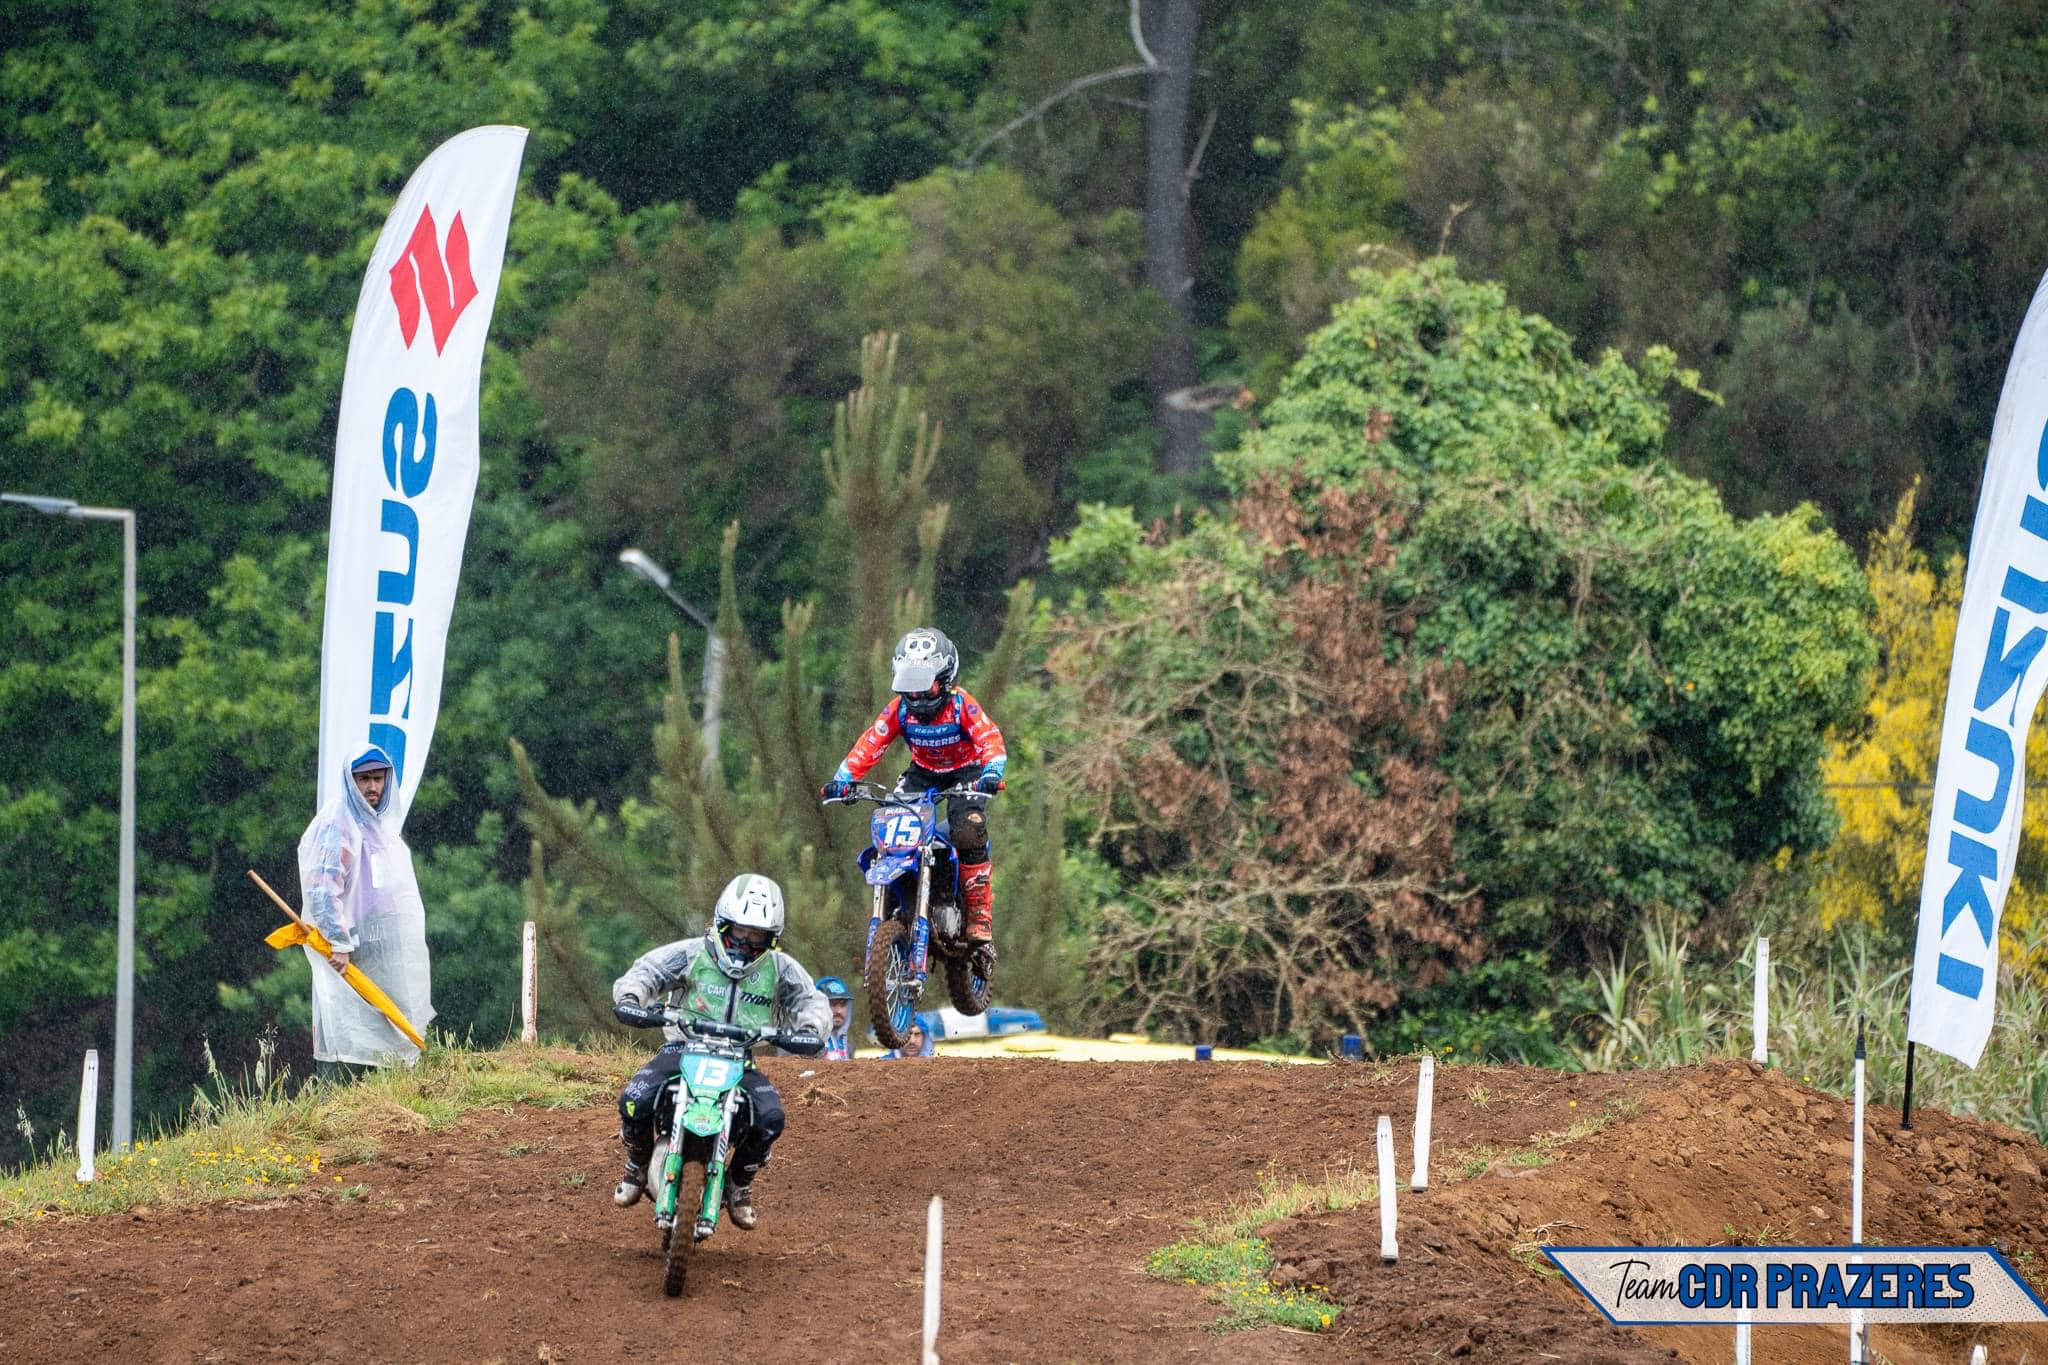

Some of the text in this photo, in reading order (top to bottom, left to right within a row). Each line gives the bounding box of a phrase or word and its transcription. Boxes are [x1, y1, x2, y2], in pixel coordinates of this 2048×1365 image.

[884, 816, 921, 849] 15
[740, 991, 772, 1008] THOR
[694, 1059, 730, 1087] 13
